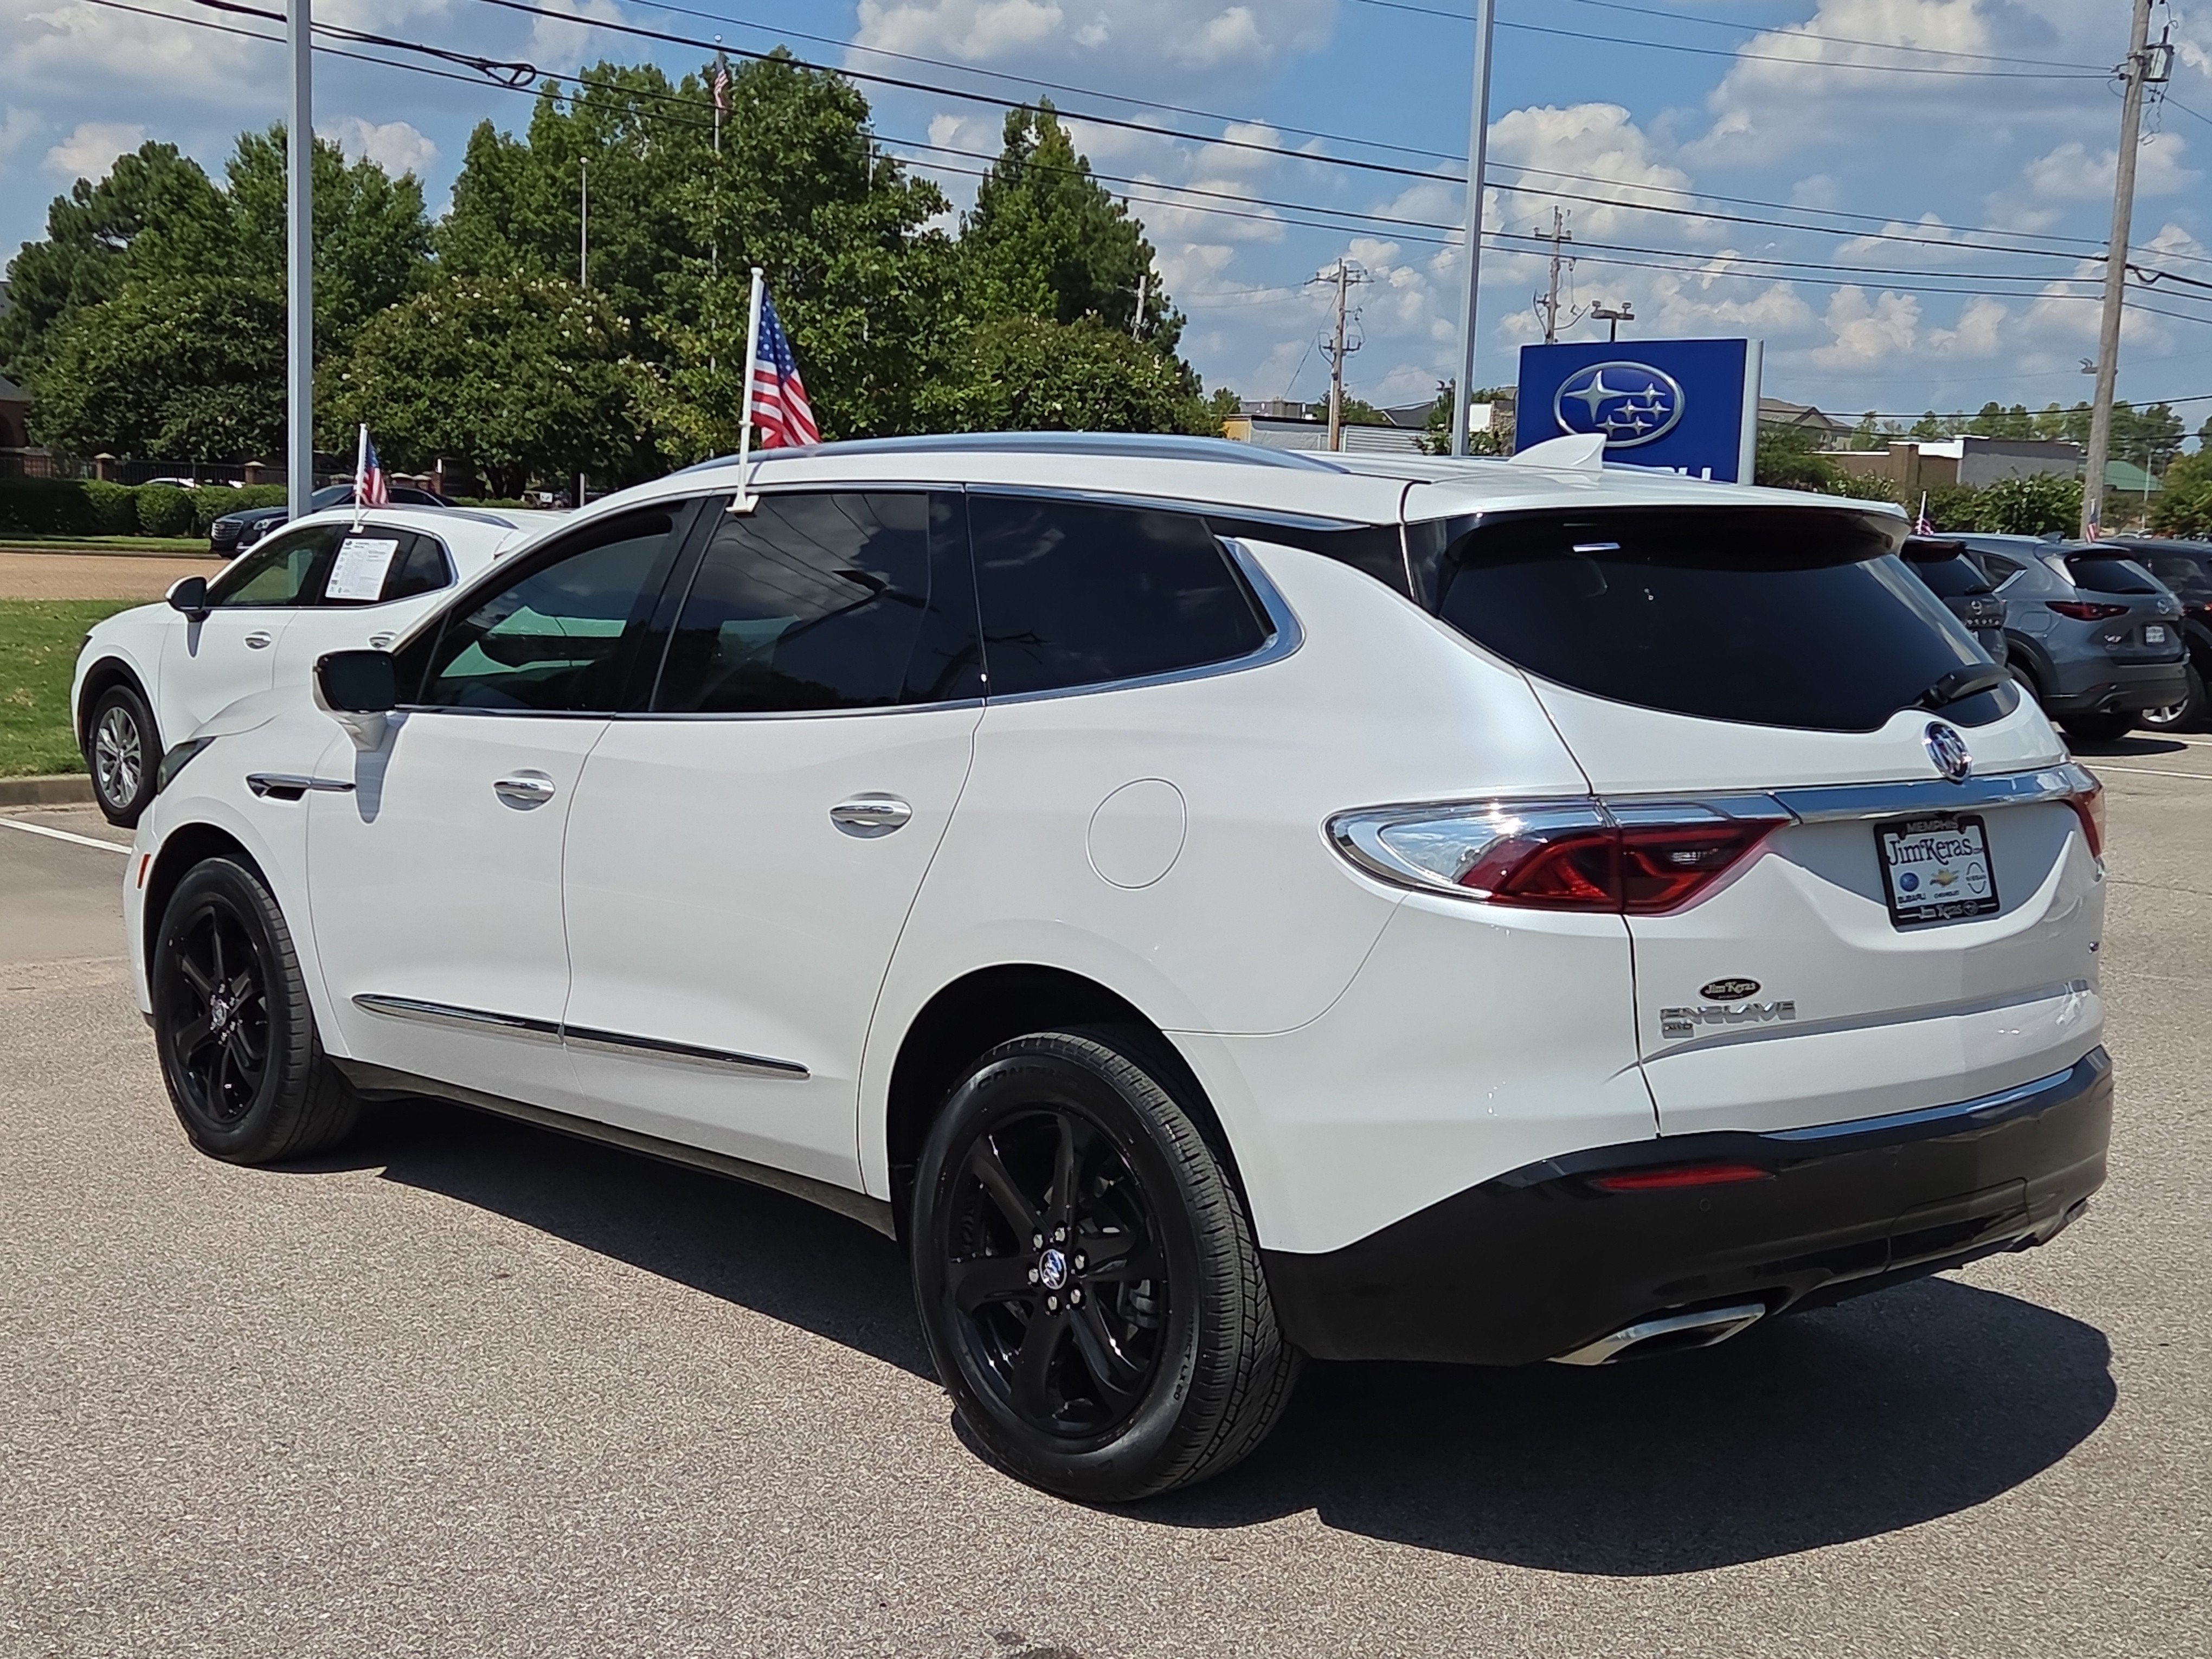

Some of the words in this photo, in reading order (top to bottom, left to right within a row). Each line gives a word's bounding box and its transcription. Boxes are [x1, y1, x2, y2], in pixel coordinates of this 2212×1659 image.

[1906, 819, 1958, 833] MEMPHIS
[1898, 893, 1926, 903] SUBARU
[1660, 1000, 1796, 1025] ENCLAVE
